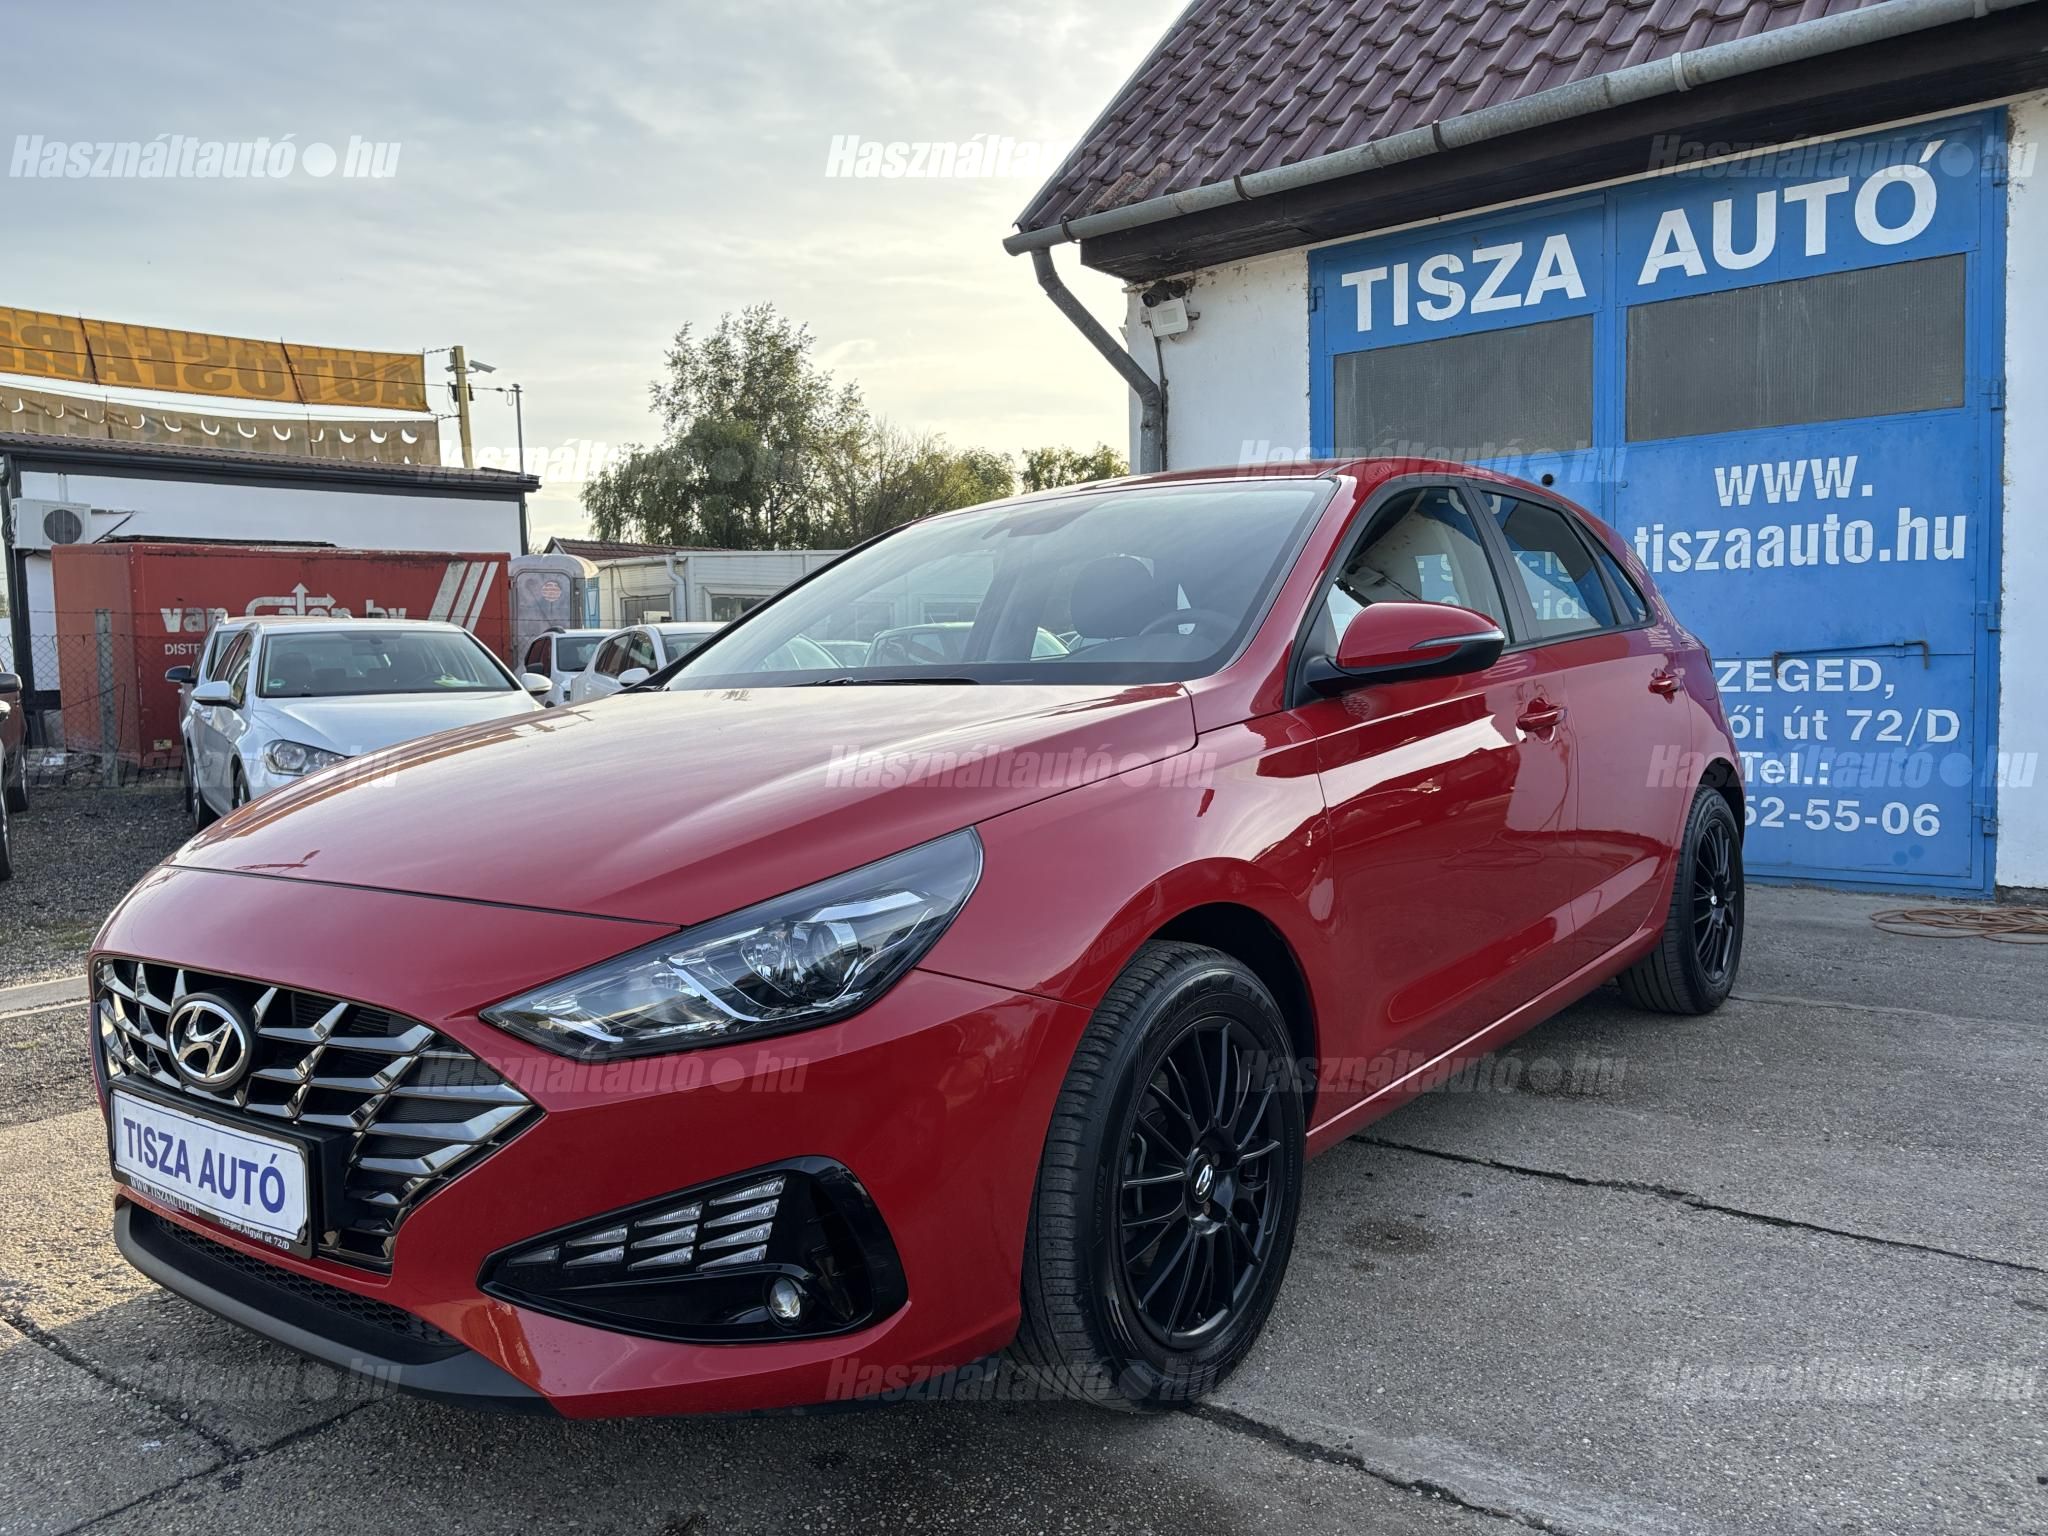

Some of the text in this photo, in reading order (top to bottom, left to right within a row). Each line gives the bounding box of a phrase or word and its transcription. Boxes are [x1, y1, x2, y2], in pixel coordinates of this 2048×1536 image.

[1342, 139, 1945, 333] TISZA AUTÓ
[1713, 455, 1873, 507] www.
[1634, 507, 1966, 573] tiszaauto.hu
[1714, 659, 1895, 700] ZEGED,
[1783, 705, 1829, 741] út
[1846, 708, 1961, 747] 72/D
[1739, 751, 1831, 786] Tel.:
[123, 1117, 286, 1214] TISZA AUTÓ
